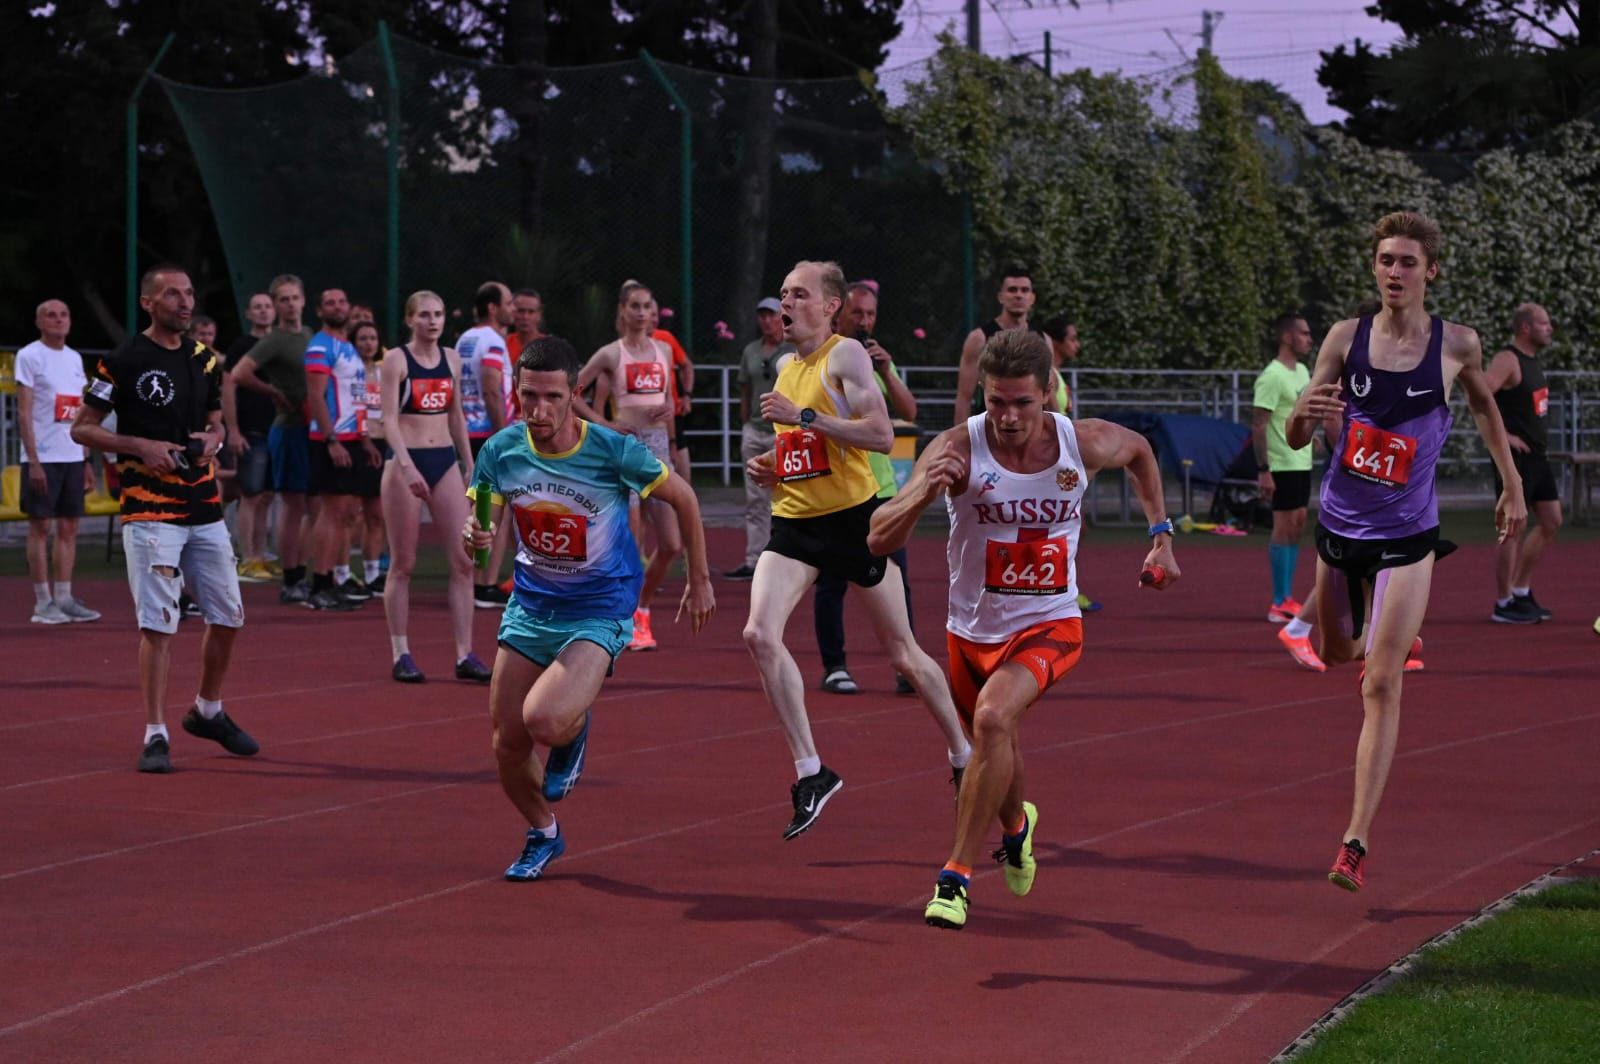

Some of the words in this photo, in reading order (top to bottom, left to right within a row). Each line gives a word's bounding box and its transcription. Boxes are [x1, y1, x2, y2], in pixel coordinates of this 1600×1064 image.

[634, 374, 661, 389] 643
[420, 391, 447, 409] 653
[783, 449, 812, 473] 651
[1352, 446, 1395, 477] 641
[547, 483, 602, 516] ПЕРВЫХ
[971, 498, 1080, 525] RUSSIA
[528, 529, 571, 554] 652
[1001, 562, 1056, 586] 642
